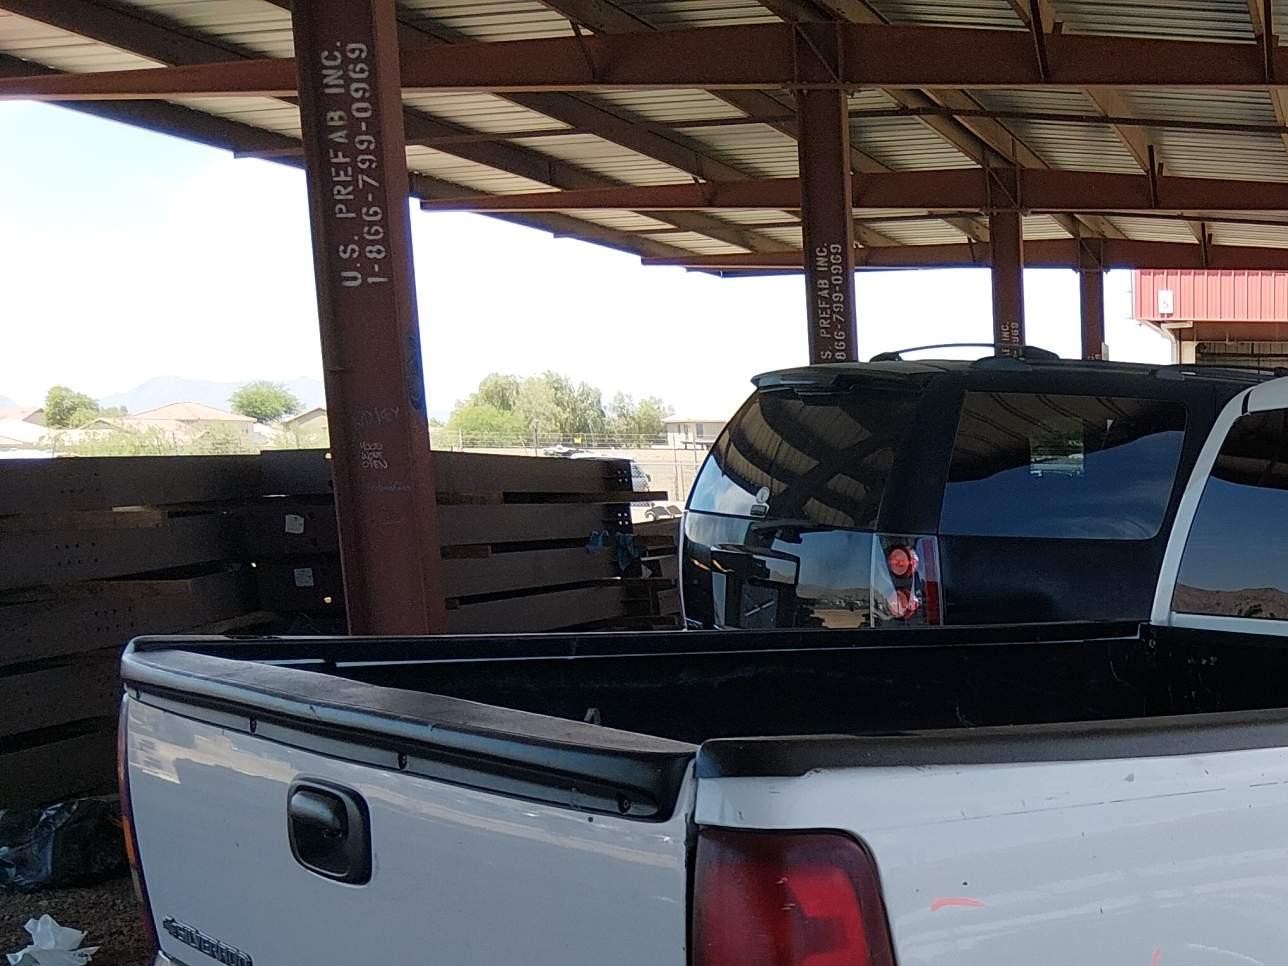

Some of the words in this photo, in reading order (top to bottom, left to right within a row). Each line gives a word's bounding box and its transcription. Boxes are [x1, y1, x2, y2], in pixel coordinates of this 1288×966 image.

[320, 41, 345, 94] INC.
[326, 110, 356, 218] PREFAB
[346, 42, 389, 285] 1-866-799-0969
[339, 235, 363, 287] U.S.
[816, 243, 828, 271] INC.
[818, 279, 831, 338] PREFAB
